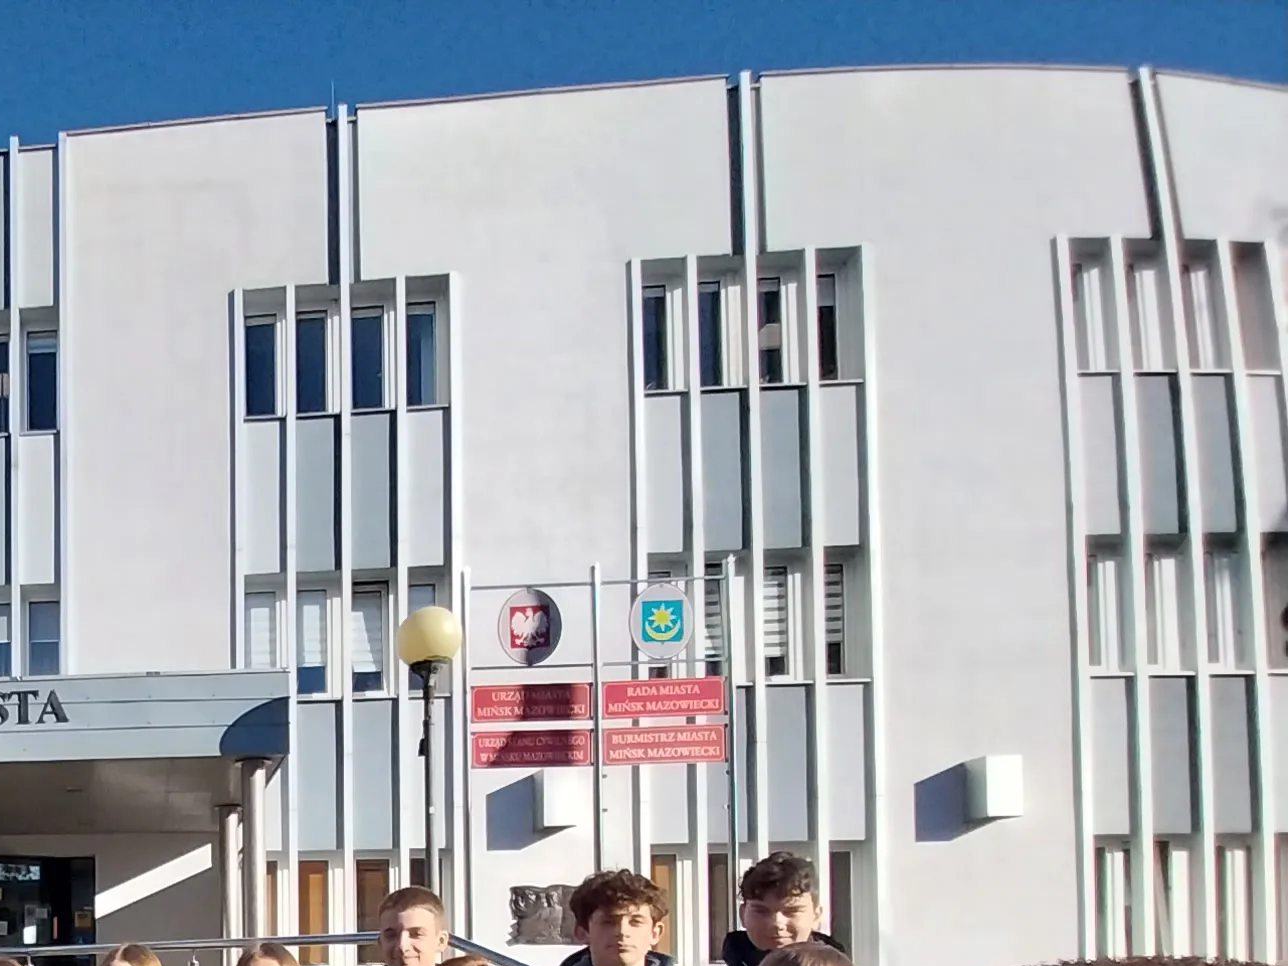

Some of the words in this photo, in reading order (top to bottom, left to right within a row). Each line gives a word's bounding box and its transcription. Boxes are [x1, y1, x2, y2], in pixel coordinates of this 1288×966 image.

[627, 686, 657, 697] RADA
[659, 685, 700, 696] MIASTA
[477, 705, 511, 717] MIŃSK
[608, 699, 644, 713] MIŃSK
[646, 698, 719, 711] MAZOWIECKI
[612, 732, 675, 744] BURMISTRZ
[677, 731, 717, 742] MIASTA
[609, 747, 645, 759] MIŃSK
[647, 745, 720, 758] MAZOWIECKI
